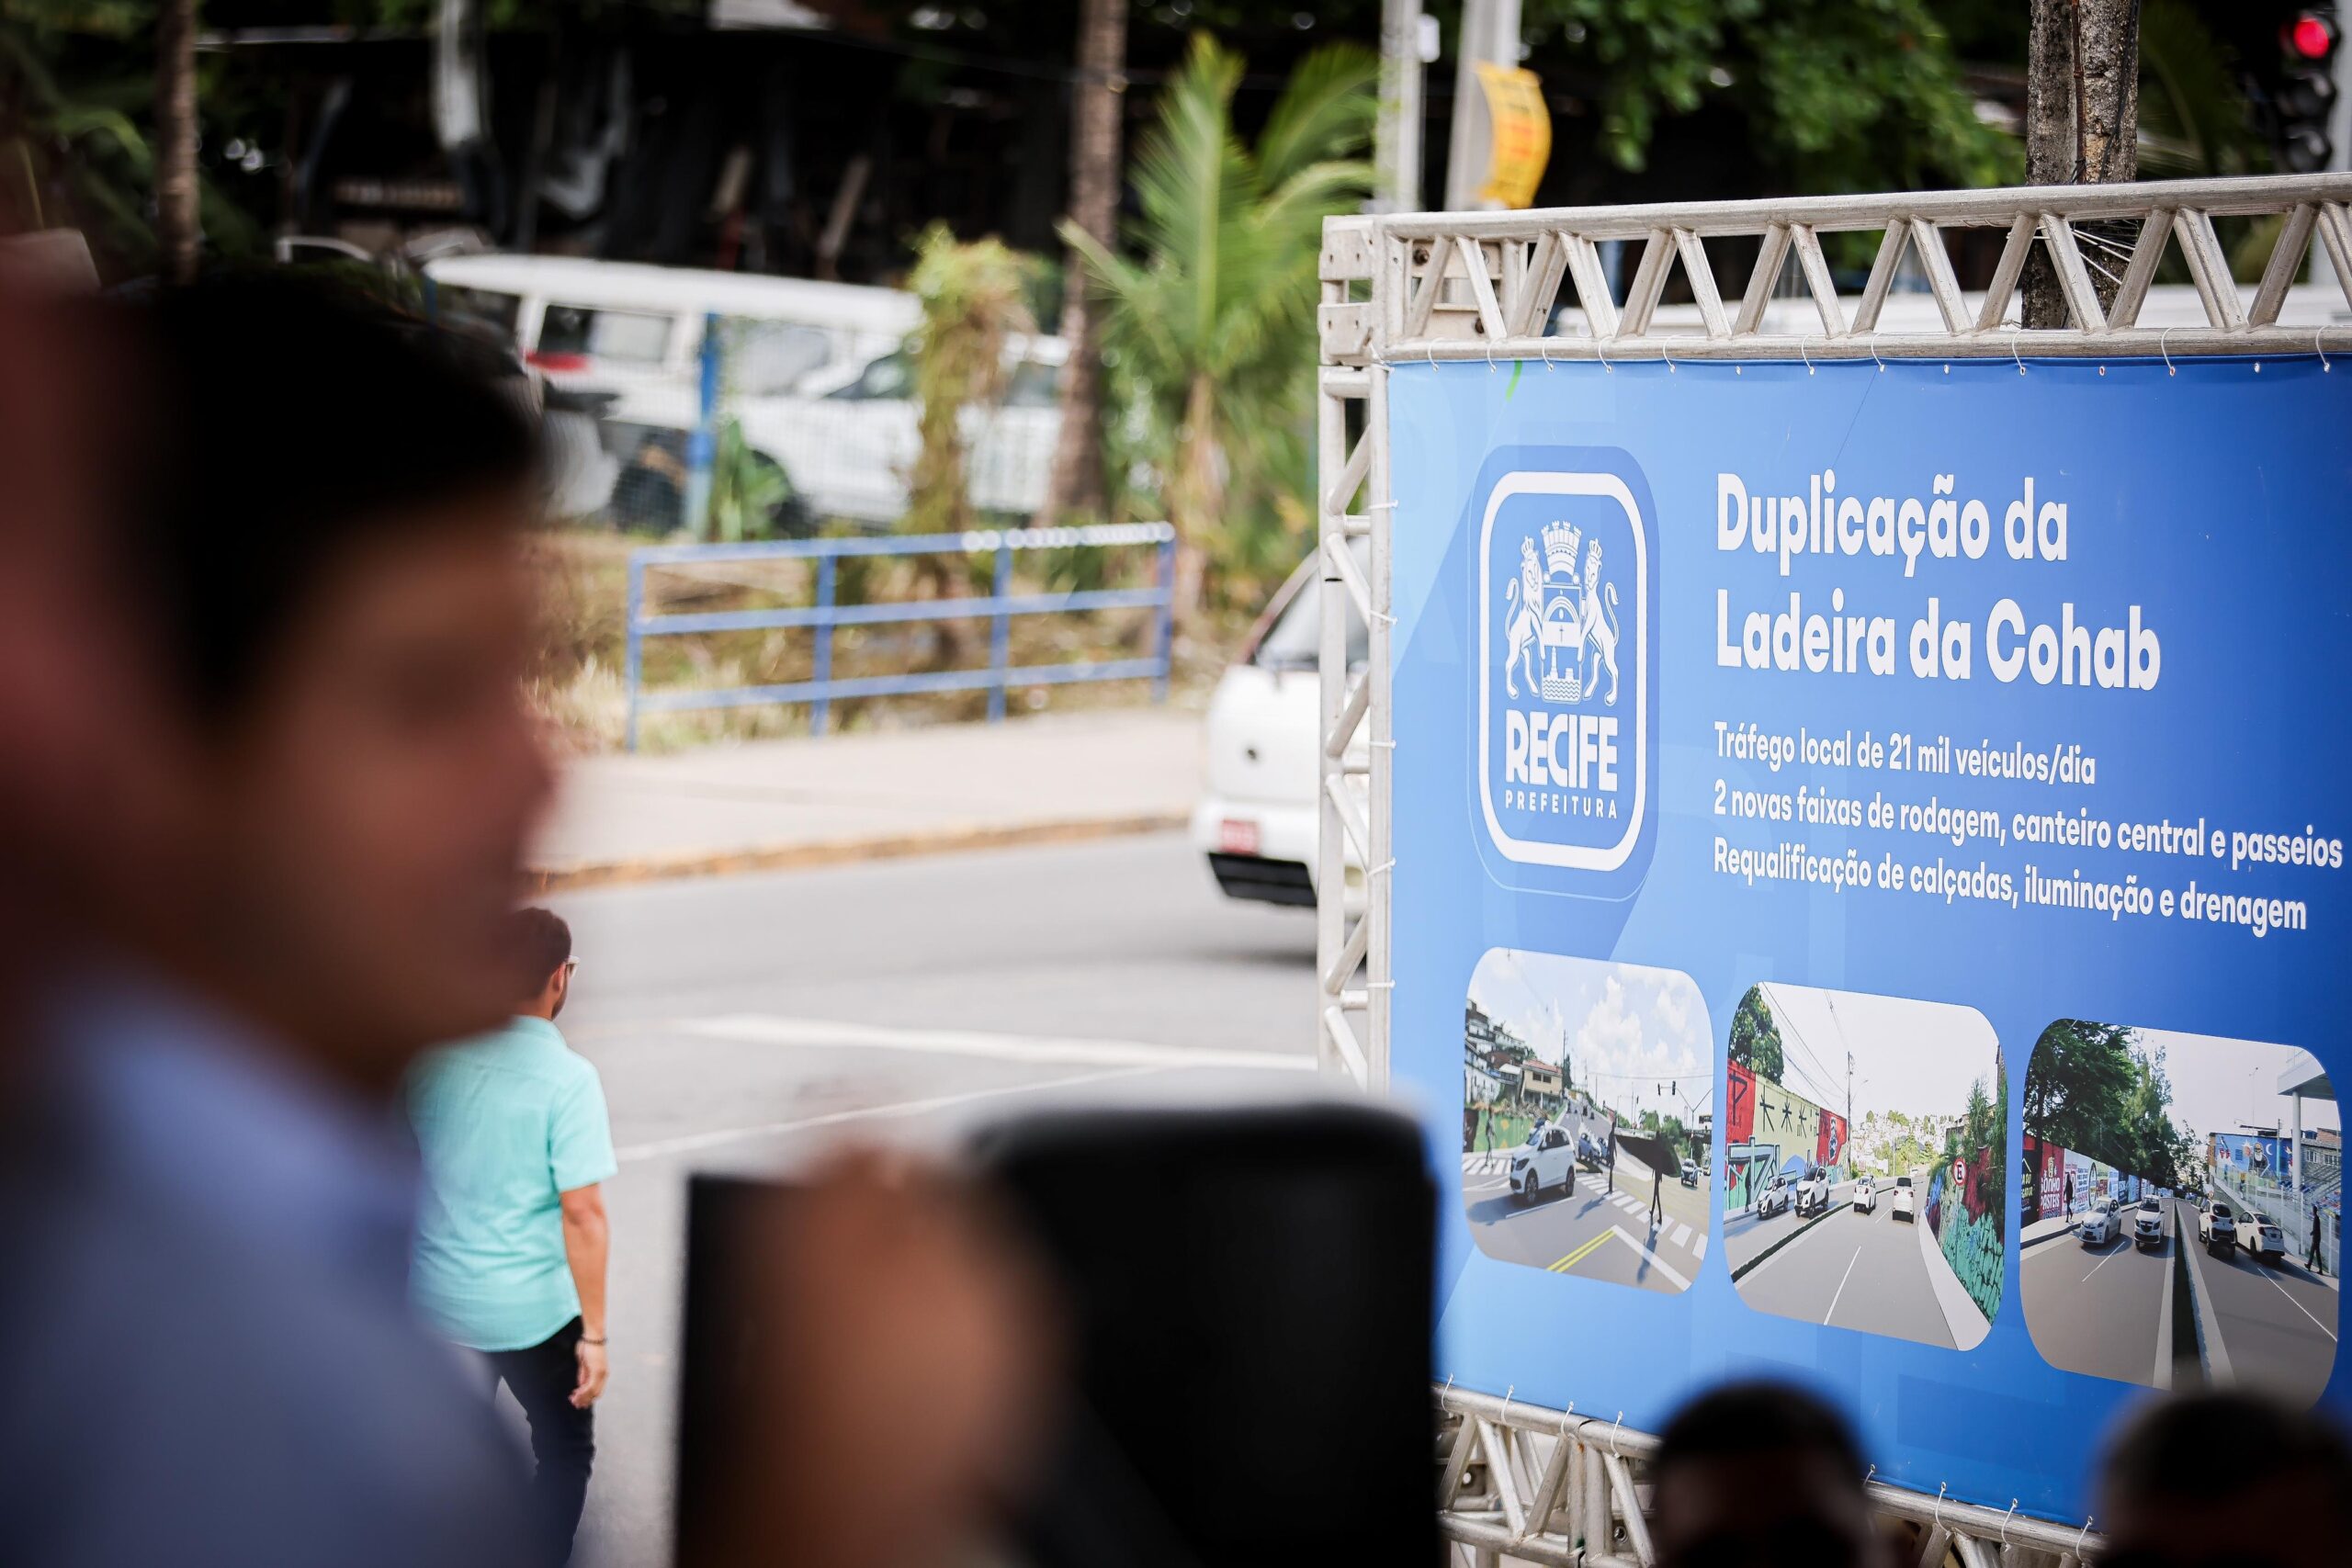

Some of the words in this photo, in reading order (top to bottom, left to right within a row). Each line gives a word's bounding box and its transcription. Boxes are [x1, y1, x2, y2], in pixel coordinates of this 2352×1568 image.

[1717, 468, 1990, 578] Duplicação
[2004, 477, 2067, 561] da
[1717, 587, 1895, 676] Ladeira
[1909, 597, 1971, 681] da
[1985, 598, 2161, 691] Cohab
[1505, 709, 1619, 792] RECIFE
[1713, 720, 1795, 773] Tráfego
[1801, 727, 1851, 766] local
[1857, 731, 1884, 769] de
[1889, 732, 1911, 771] 21
[1917, 735, 1950, 773] mil
[1954, 739, 2096, 787] veículos/dia
[1504, 789, 1618, 819] PREFEITURA
[1713, 778, 1727, 816] 2
[1731, 790, 1792, 821] novas
[1796, 784, 1862, 828] faixas
[1867, 791, 1894, 829] de
[1900, 796, 2007, 847] rodagem,
[2012, 807, 2111, 849] canteiro
[2117, 818, 2205, 856] central
[2211, 829, 2226, 858] e
[2232, 825, 2342, 871] passeios
[1713, 836, 1872, 894] Requalificação
[1877, 852, 1905, 892] de
[1909, 857, 2018, 909] calçadas,
[2025, 863, 2154, 921] iluminação
[2159, 889, 2175, 917] e
[2180, 881, 2306, 938] drenagem
